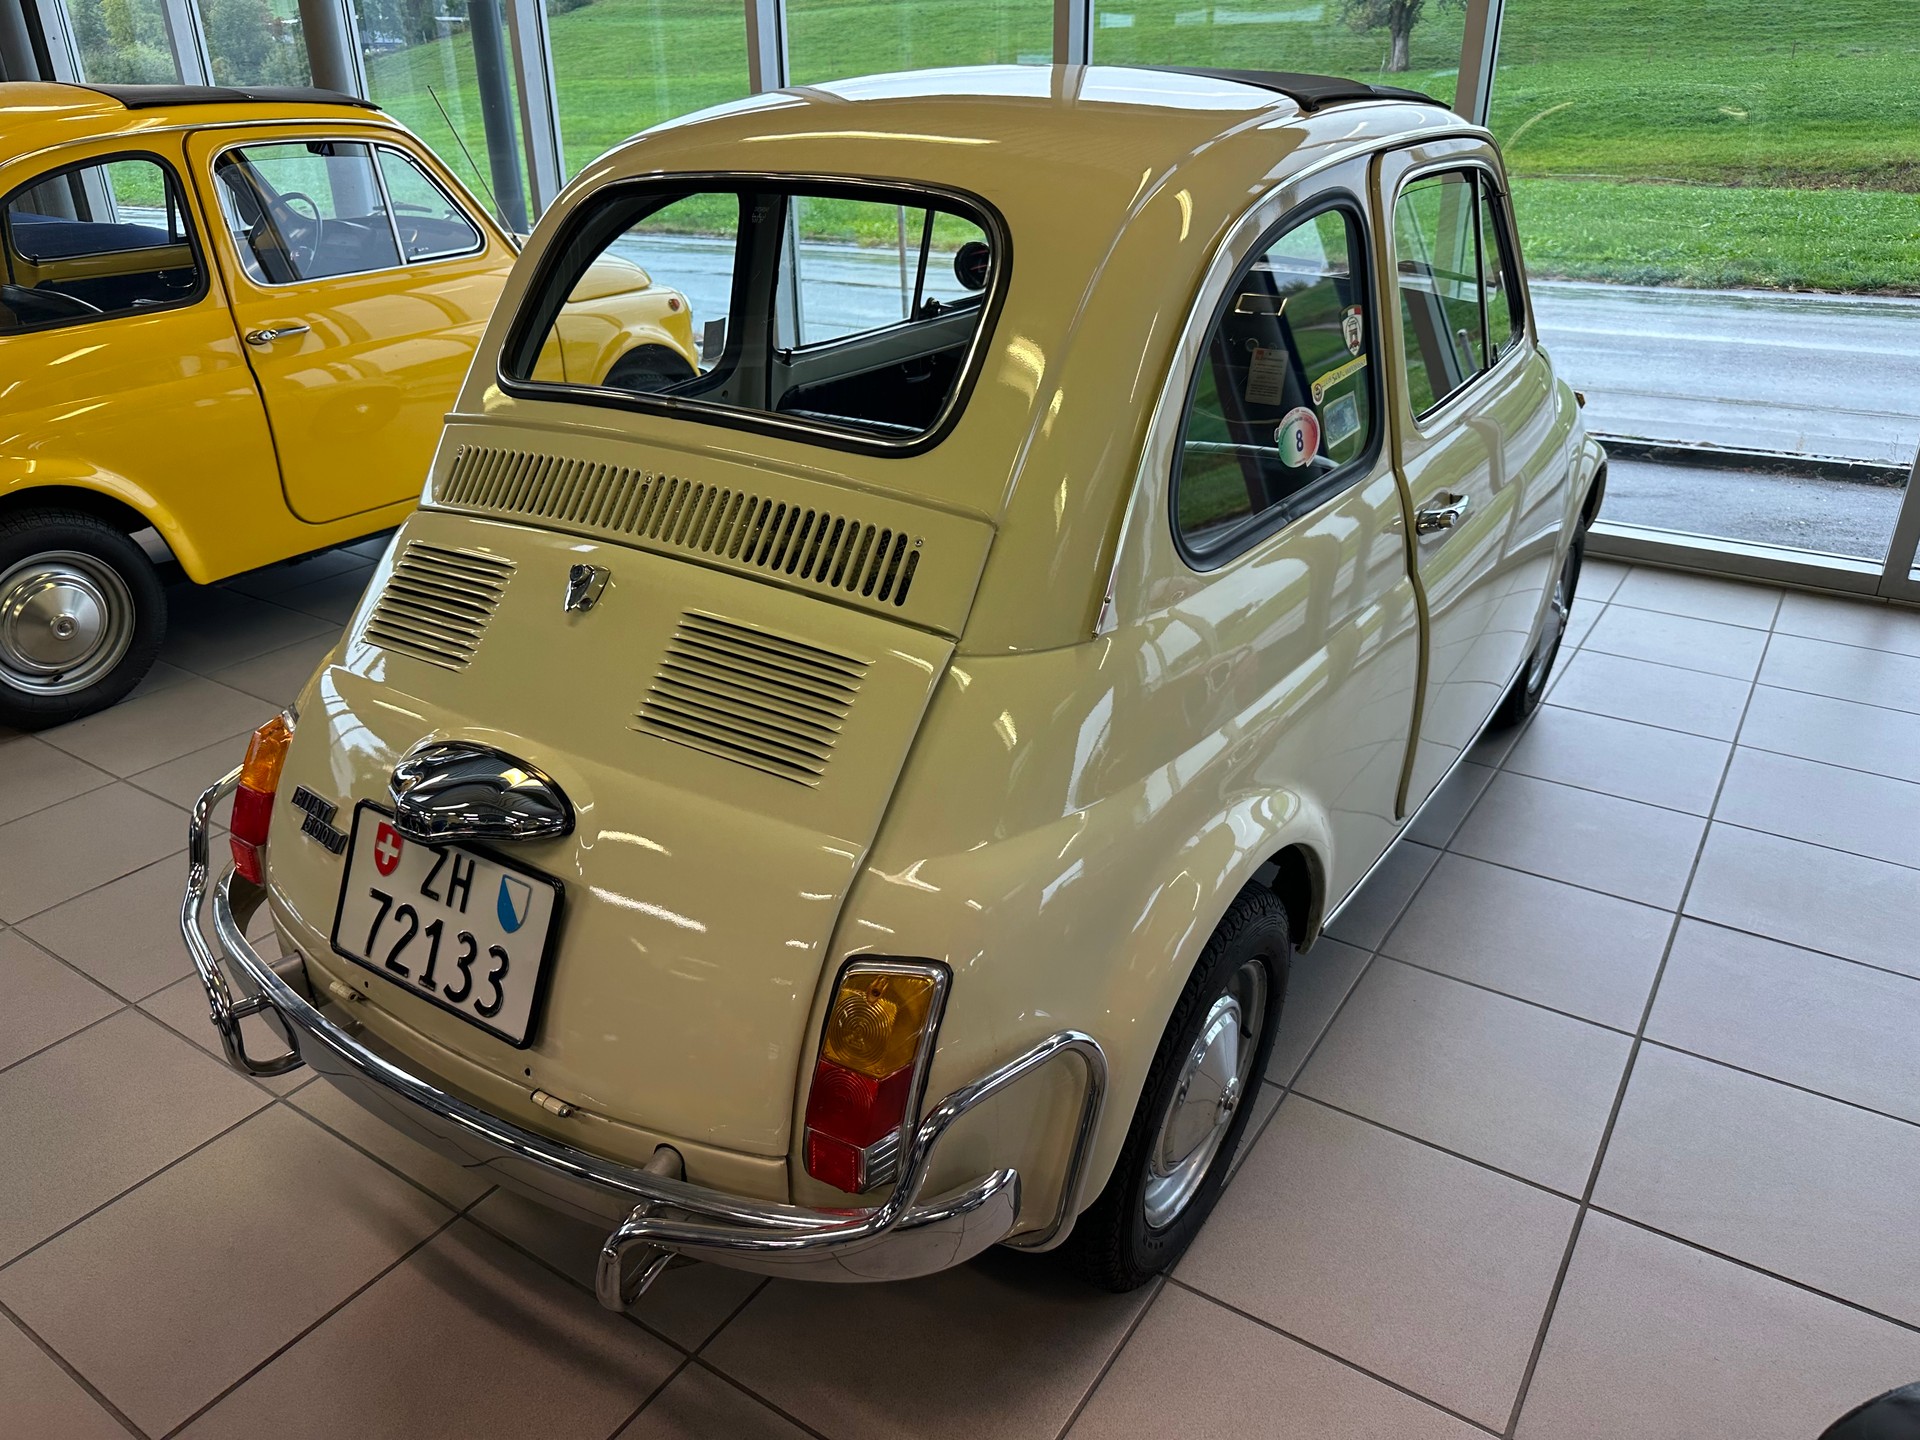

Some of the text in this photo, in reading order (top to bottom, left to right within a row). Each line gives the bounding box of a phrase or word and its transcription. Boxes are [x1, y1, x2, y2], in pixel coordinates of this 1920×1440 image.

[1295, 429, 1304, 452] 8
[294, 787, 331, 820] FIAT
[421, 847, 475, 913] ZH
[364, 888, 510, 1018] 72133
